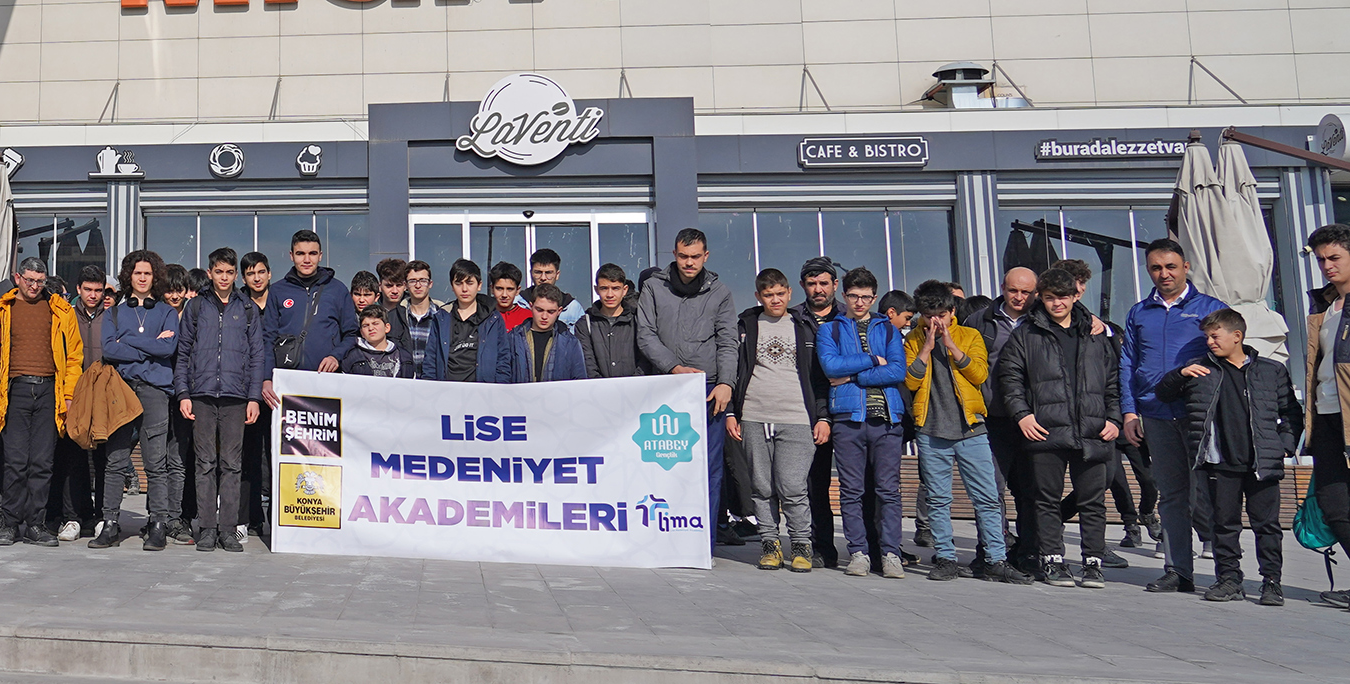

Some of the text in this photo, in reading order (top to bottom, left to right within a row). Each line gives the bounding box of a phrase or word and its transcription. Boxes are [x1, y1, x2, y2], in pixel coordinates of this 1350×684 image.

[458, 108, 602, 156] LaVenti
[805, 143, 922, 158] CAFE & BISTRO
[643, 439, 689, 451] ATABEY
[296, 497, 323, 506] KONYA
